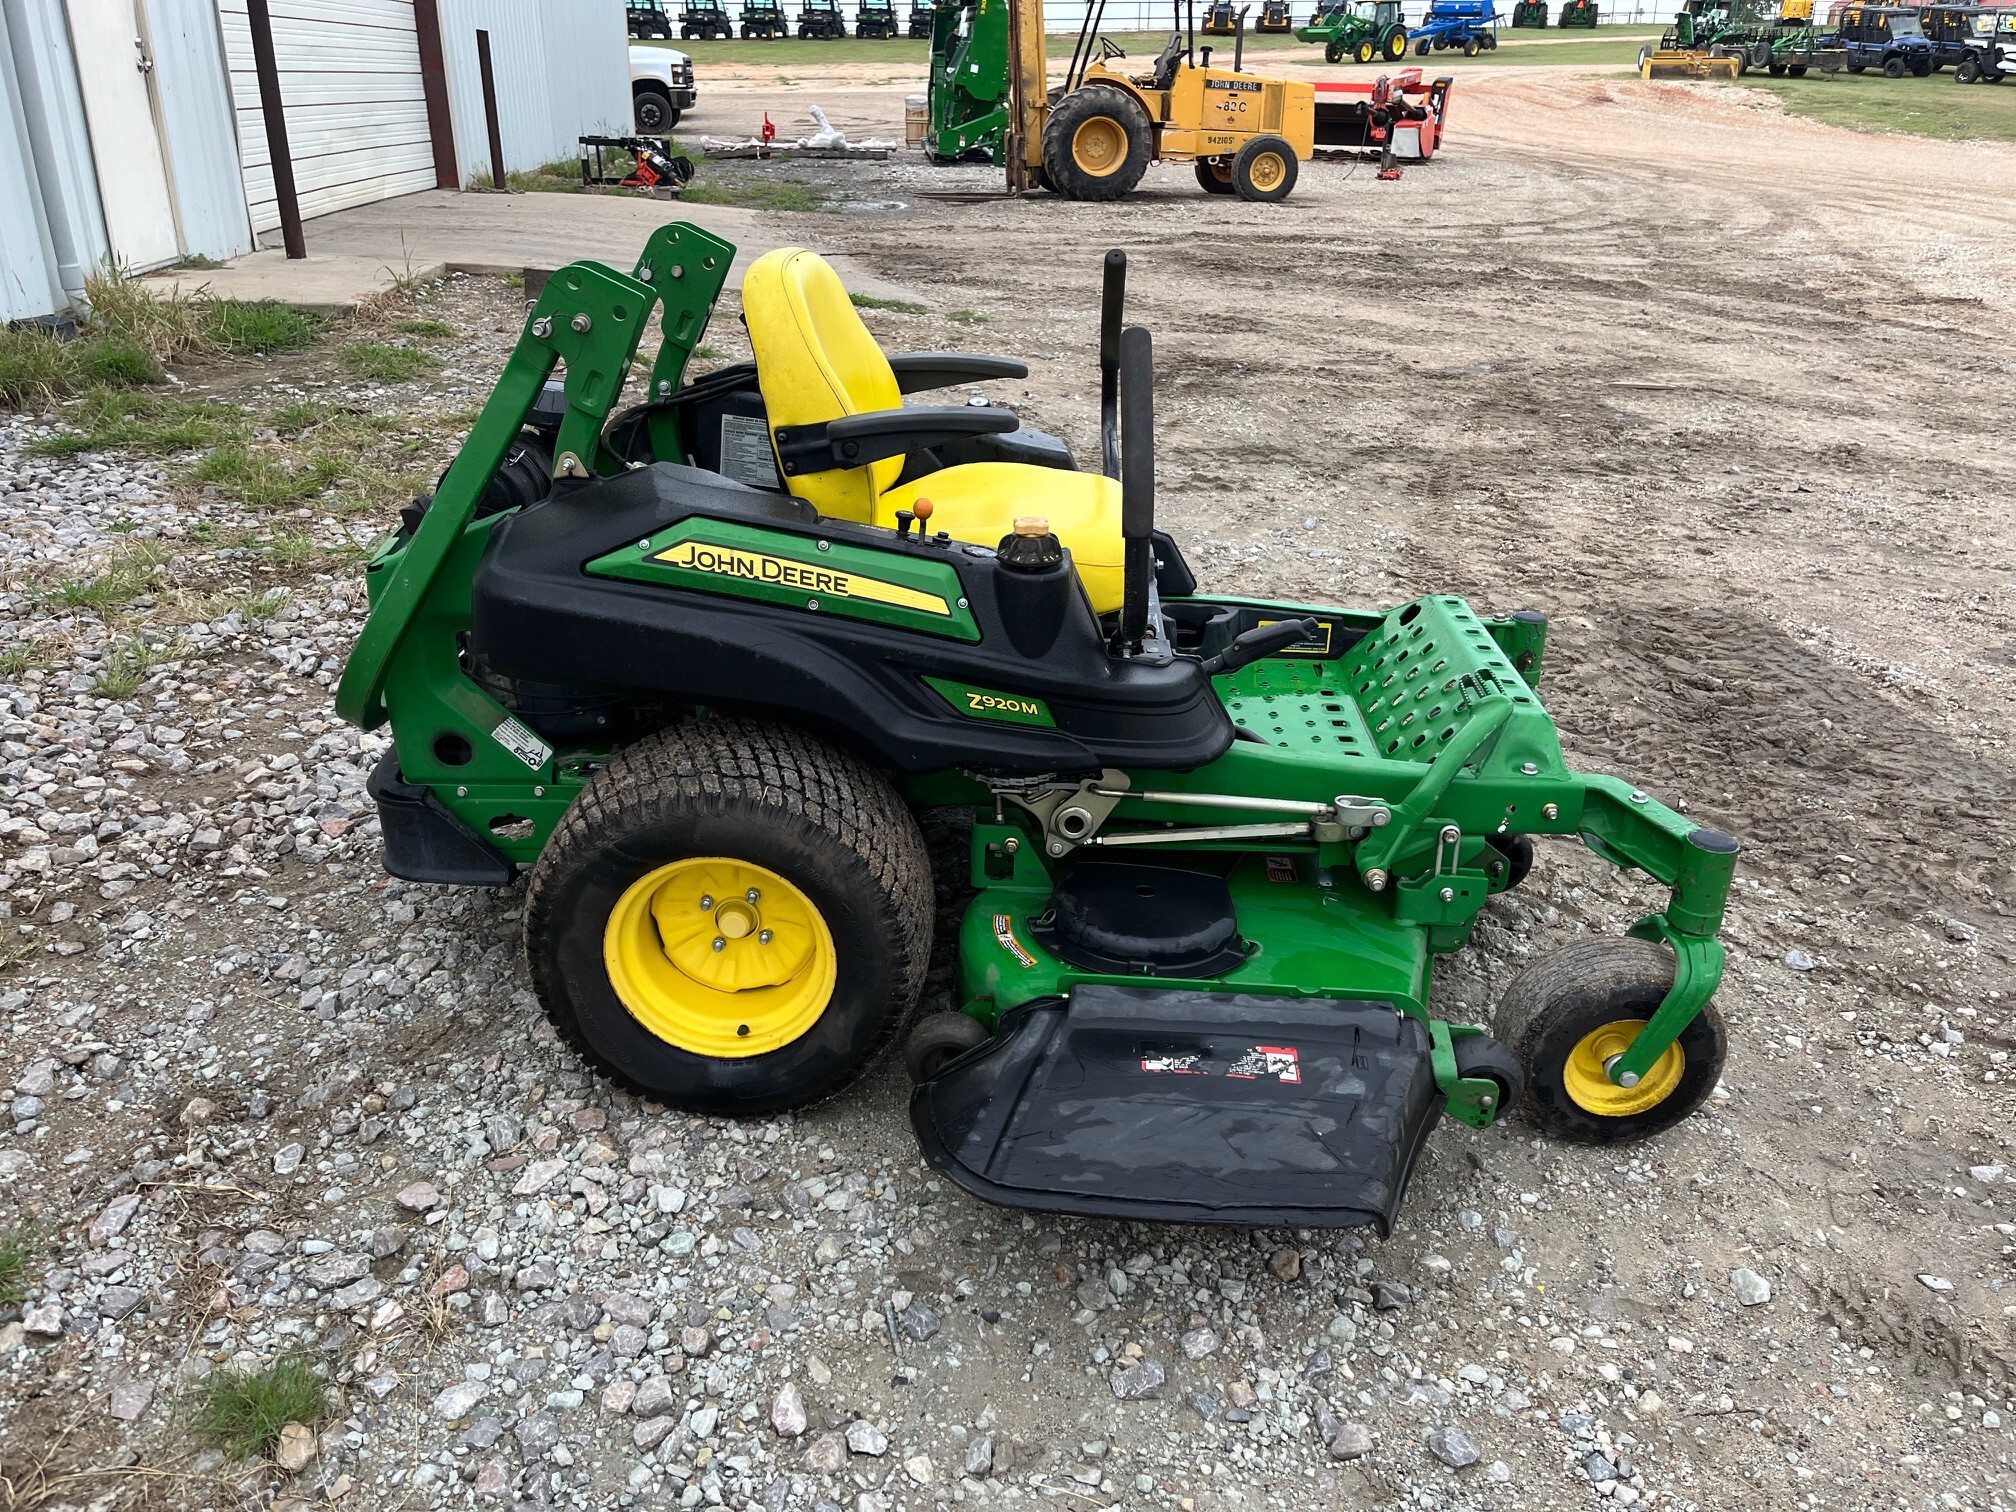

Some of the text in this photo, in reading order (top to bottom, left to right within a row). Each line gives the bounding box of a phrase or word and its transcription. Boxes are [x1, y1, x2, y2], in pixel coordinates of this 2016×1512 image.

[1210, 80, 1257, 91] JOHN DEERE
[681, 546, 849, 594] JOHN DEERE
[966, 692, 1039, 715] Z920M
